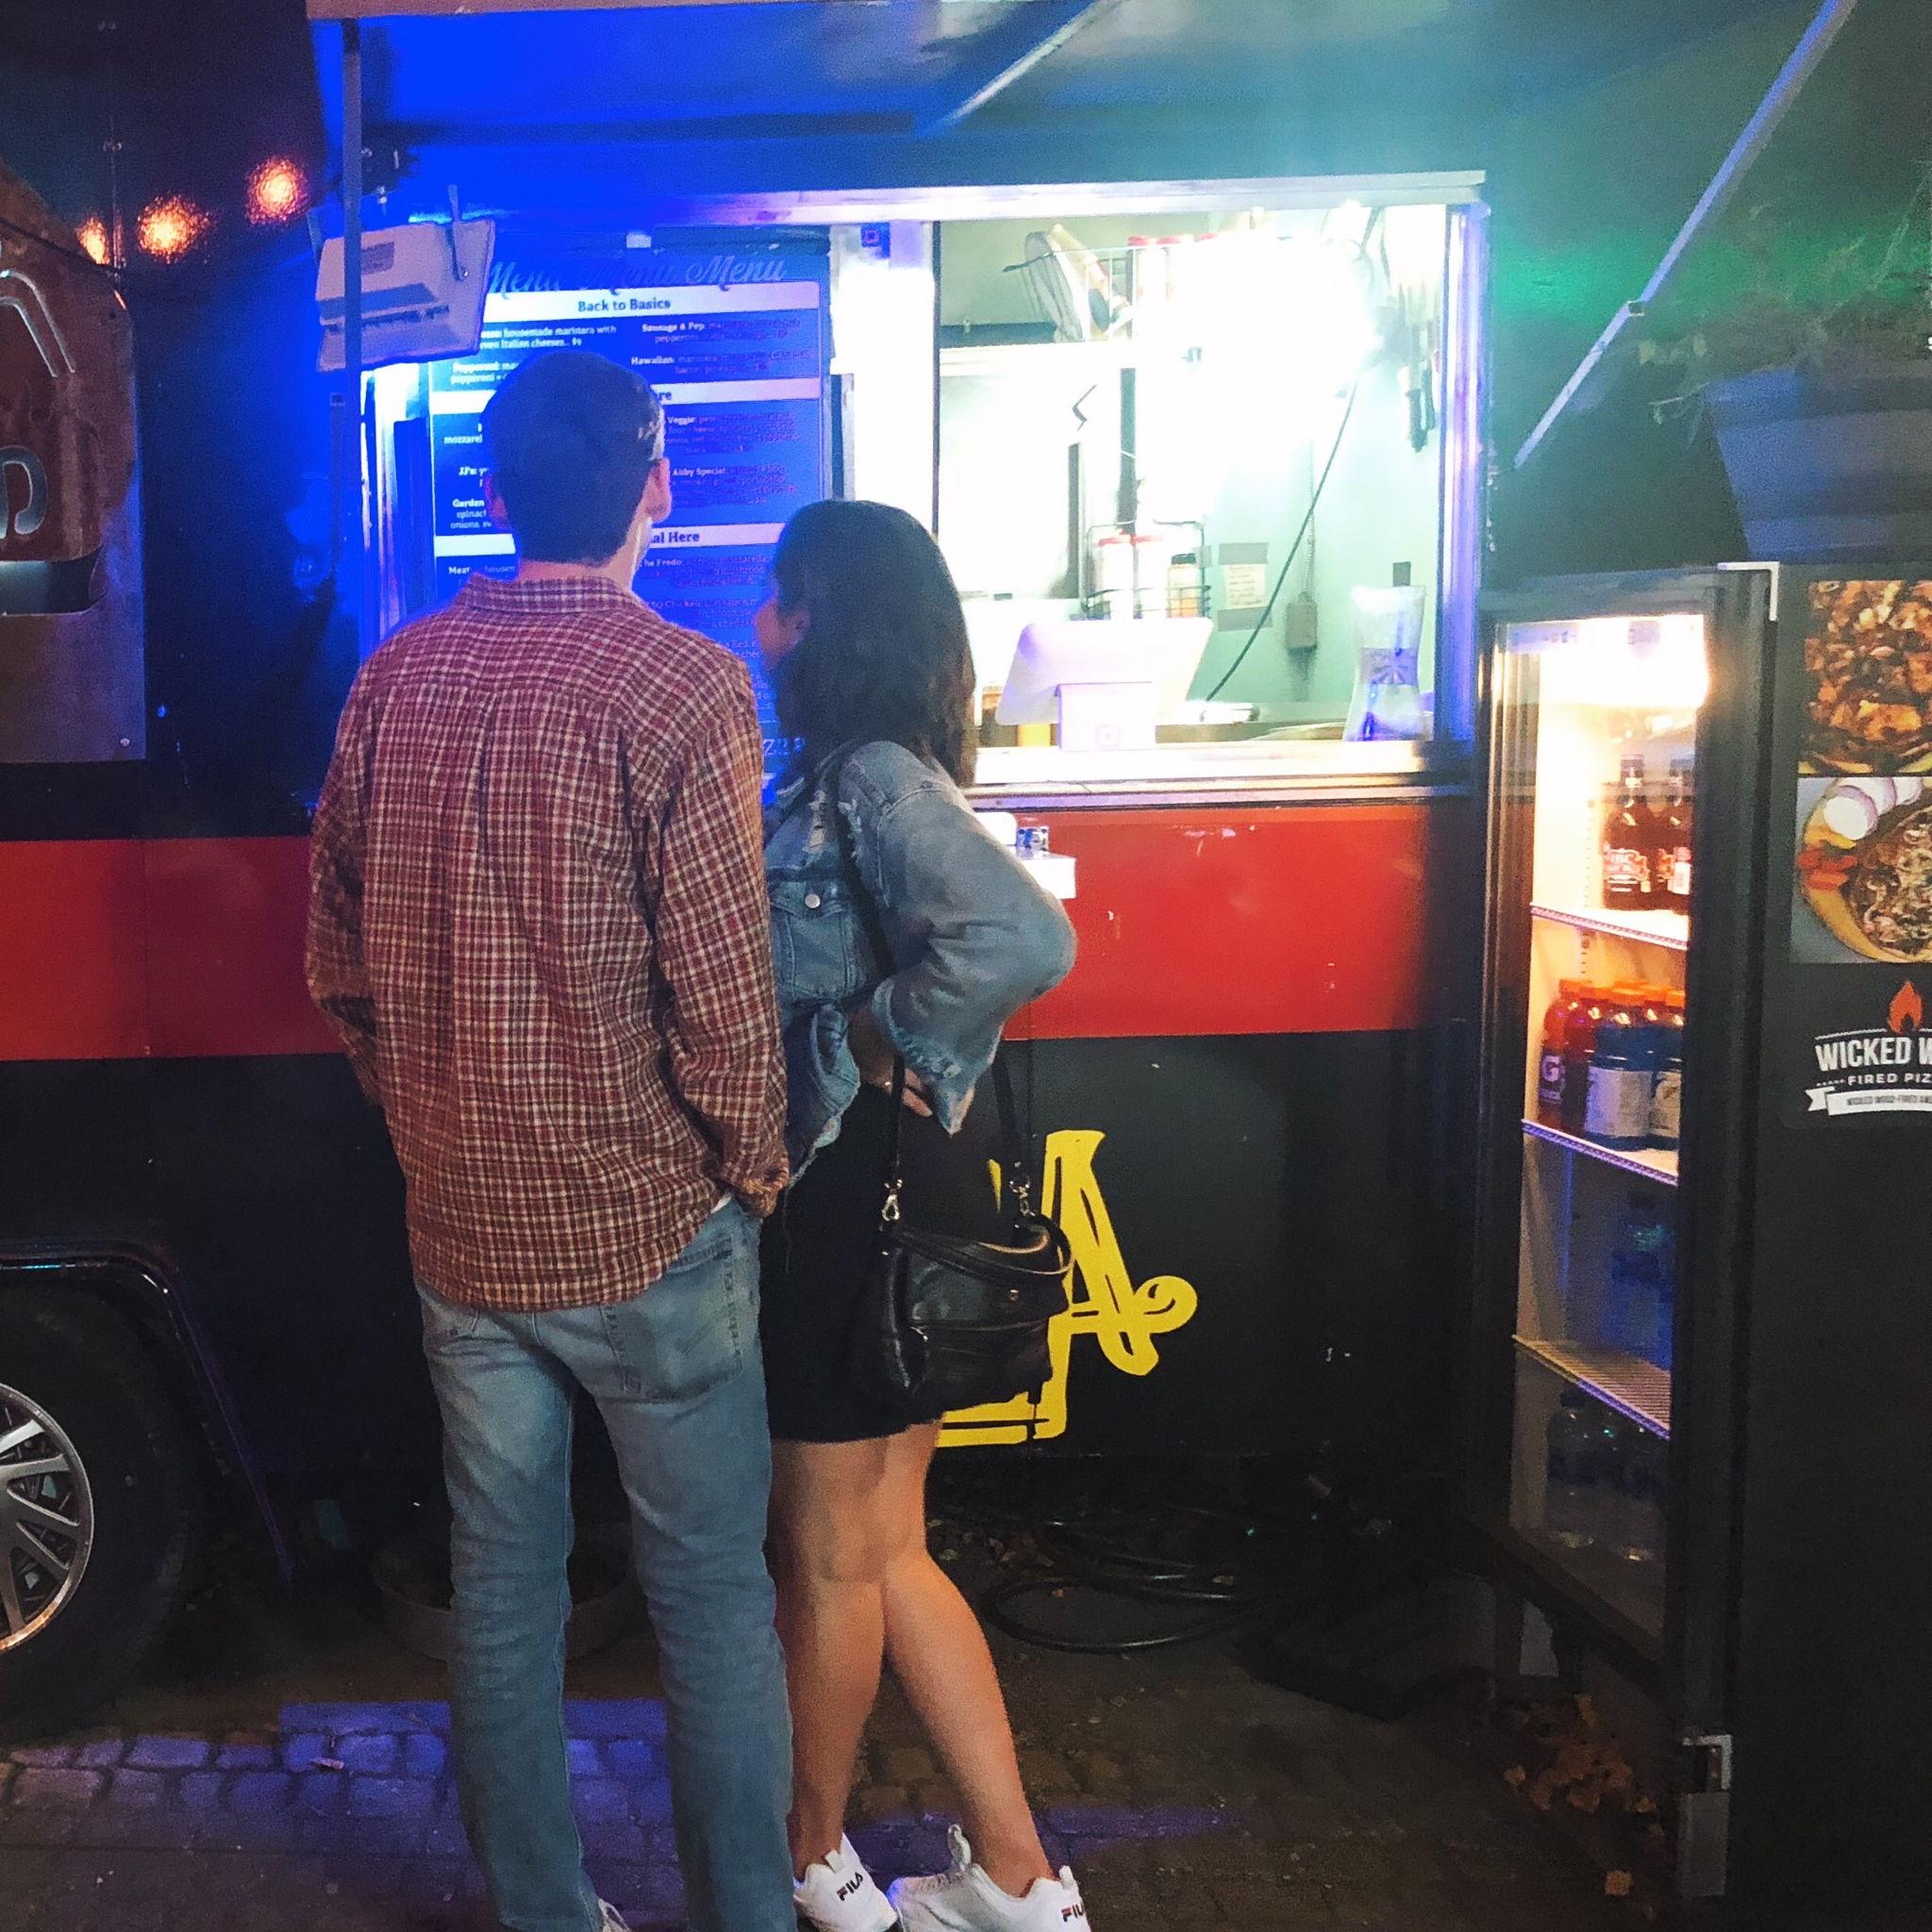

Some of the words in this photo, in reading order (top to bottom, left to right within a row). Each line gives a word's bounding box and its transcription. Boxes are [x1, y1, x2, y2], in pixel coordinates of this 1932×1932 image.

[686, 255, 788, 291] Menu
[577, 300, 609, 312] Back
[612, 301, 626, 311] to
[629, 297, 671, 310] Basics
[452, 498, 485, 508] Garden
[668, 530, 701, 543] Here
[1815, 1037, 1912, 1072] WICKED
[1847, 1073, 1899, 1087] FIRED
[1904, 1072, 1932, 1084] PIZ
[836, 1872, 864, 1903] FILA
